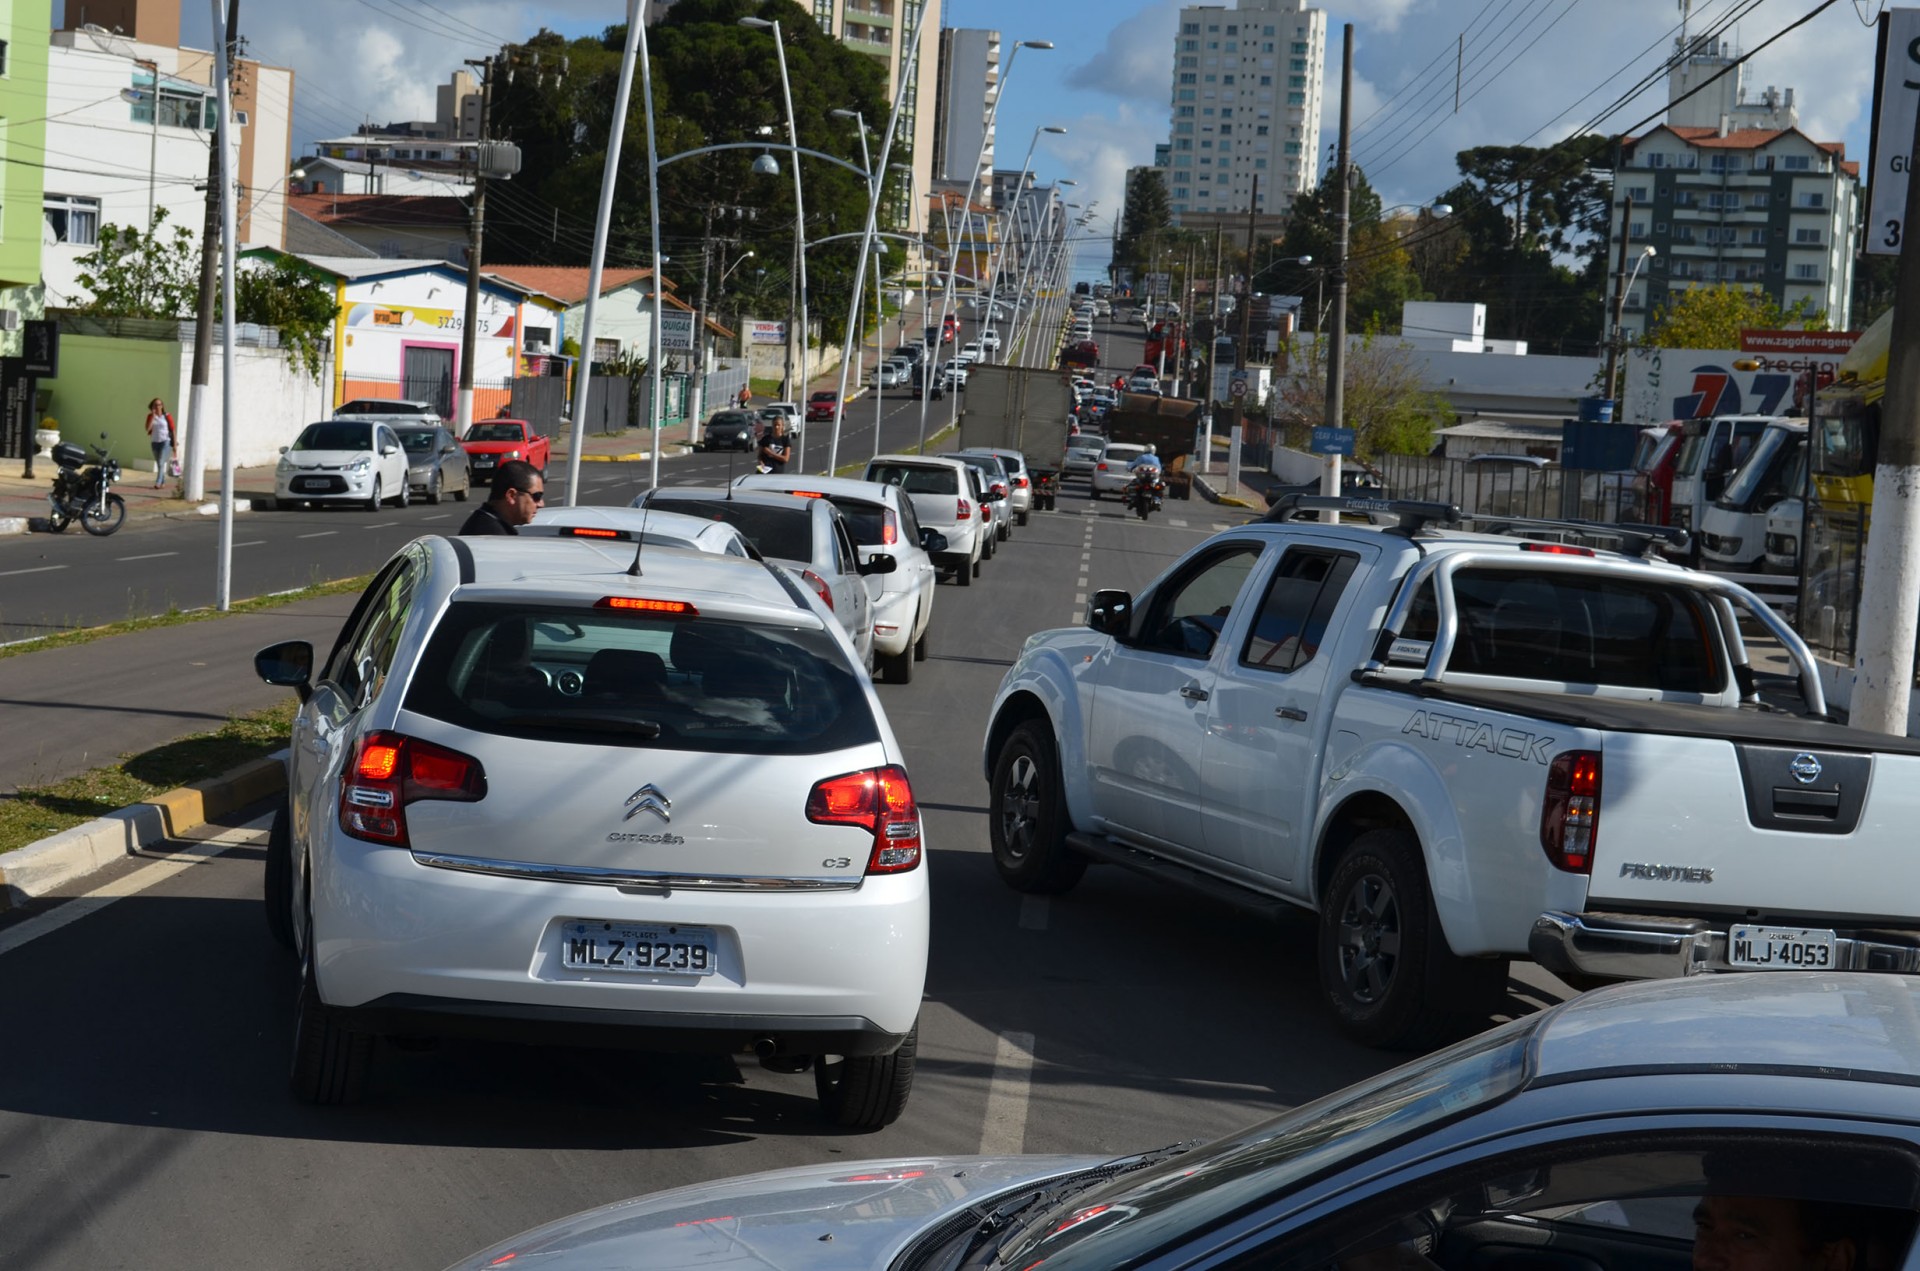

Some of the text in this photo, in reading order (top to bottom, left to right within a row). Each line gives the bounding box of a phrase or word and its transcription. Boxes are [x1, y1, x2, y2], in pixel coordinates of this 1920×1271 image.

[661, 320, 690, 332] IQUIGAS
[1402, 709, 1555, 765] ATTACK
[1619, 862, 1715, 883] FRONTIER
[622, 930, 659, 939] SC-LAGES
